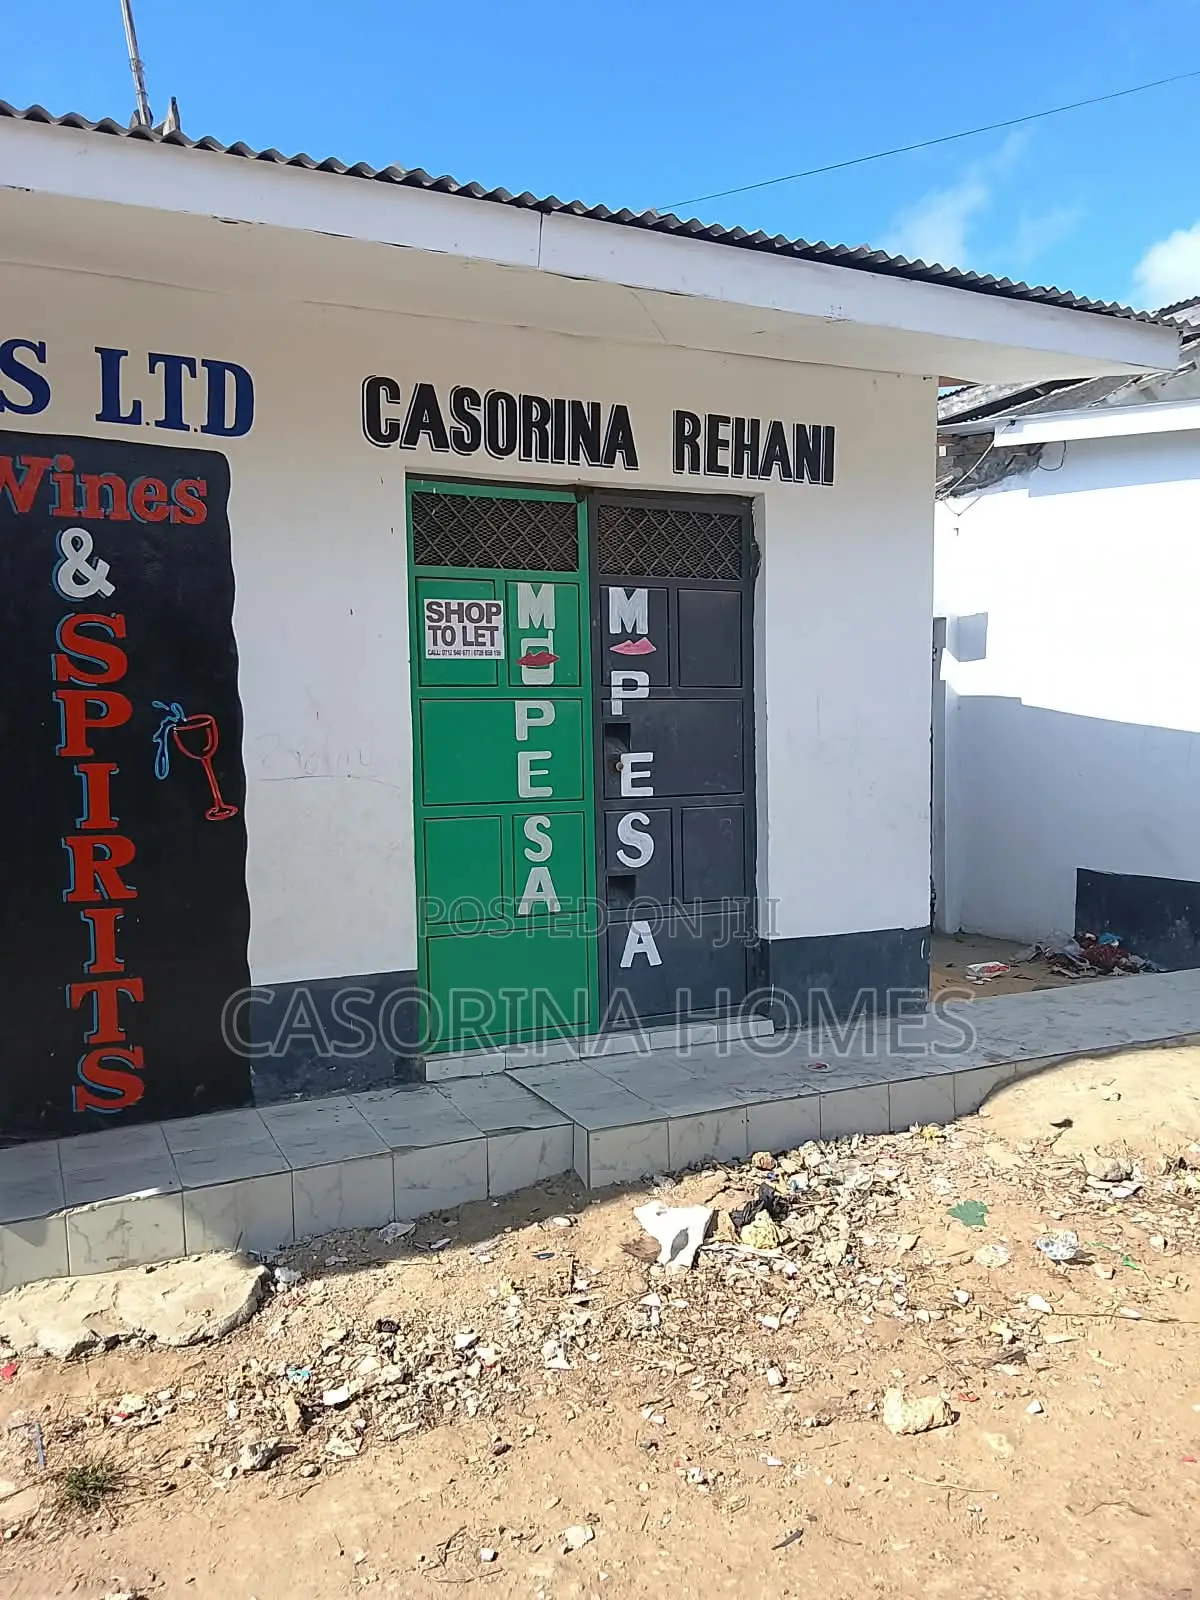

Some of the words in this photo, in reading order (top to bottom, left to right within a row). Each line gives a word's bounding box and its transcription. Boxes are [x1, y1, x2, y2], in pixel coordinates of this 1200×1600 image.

[361, 374, 640, 471] CASORINA
[672, 409, 837, 487] REHANI
[0, 454, 208, 525] Wines
[51, 527, 116, 601] &
[426, 601, 502, 624] SHOP
[427, 625, 456, 647] TO
[462, 625, 499, 647] LET
[51, 612, 146, 1114] SPIRITS
